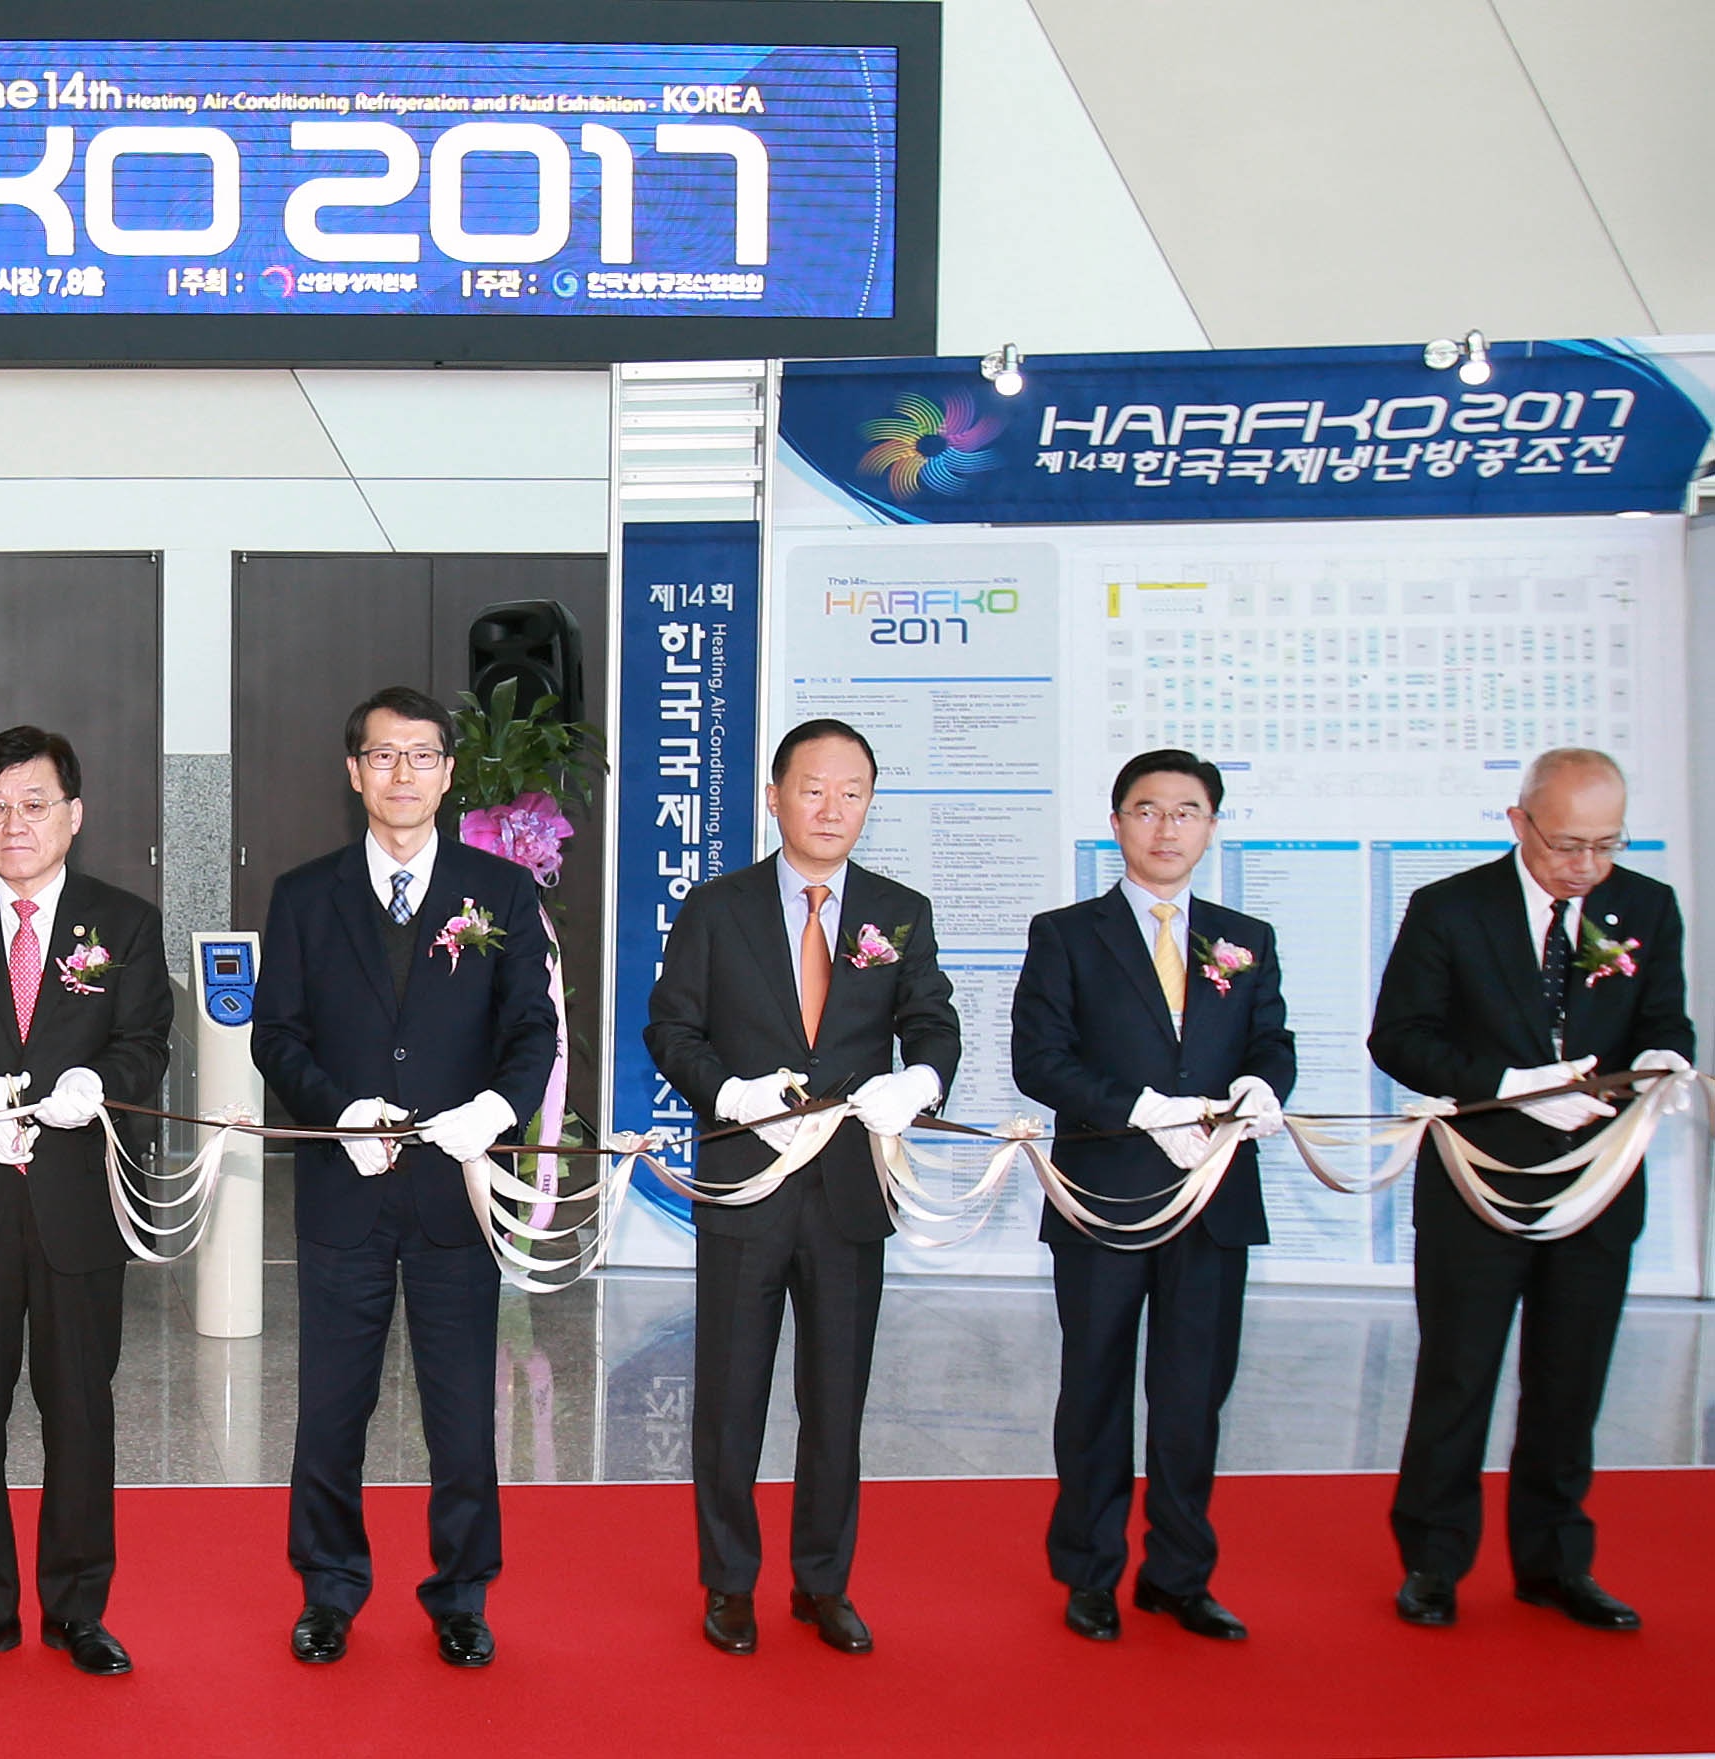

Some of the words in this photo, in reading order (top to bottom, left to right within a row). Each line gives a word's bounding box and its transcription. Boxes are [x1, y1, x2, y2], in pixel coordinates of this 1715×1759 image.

[42, 71, 122, 110] 14th
[126, 92, 198, 114] Heating
[202, 92, 351, 115] Air-Conditioning
[355, 91, 469, 115] Refrigeration
[472, 94, 506, 113] and
[510, 93, 553, 113] Fluid
[556, 93, 647, 114] Exhibition
[662, 85, 765, 114] KOREA
[284, 121, 769, 266] 2017
[181, 267, 229, 297] 주최
[475, 268, 524, 298] 주관
[1038, 394, 1447, 447] HARFKO
[1449, 388, 1636, 434] 2017
[1035, 448, 1126, 474] 제14회
[1131, 433, 1628, 488] 한국국제냉난방공조전
[648, 582, 735, 613] 제14회
[825, 588, 1020, 616] HARFKO
[870, 617, 969, 645] 2017
[707, 622, 727, 693] Heating,
[704, 695, 725, 837] Air-Conditioning,
